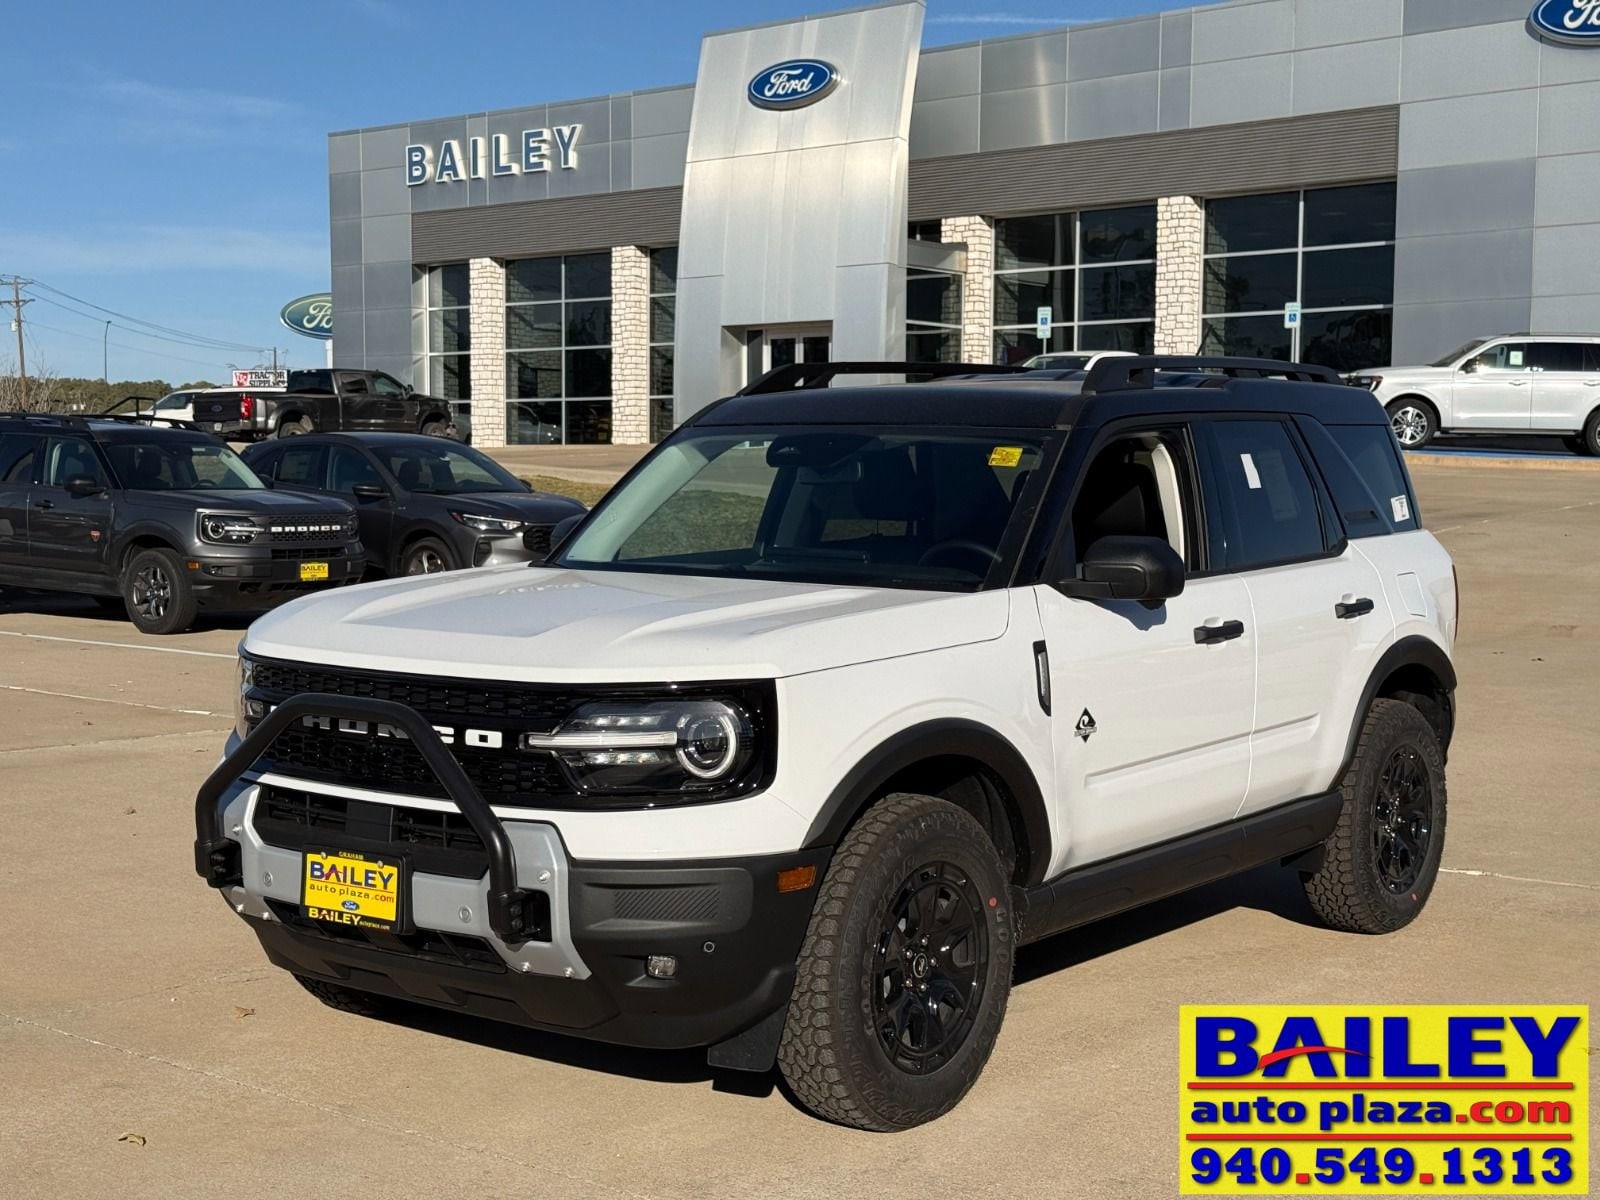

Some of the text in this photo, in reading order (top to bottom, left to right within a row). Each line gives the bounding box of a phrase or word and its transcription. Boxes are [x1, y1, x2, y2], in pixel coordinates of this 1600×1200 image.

[764, 69, 814, 96] Ford
[406, 124, 582, 186] BAILEY
[249, 371, 285, 379] TRACTOR
[270, 705, 503, 749] RONCO
[339, 851, 364, 860] GRAHAM
[310, 861, 394, 890] BAILEY
[309, 883, 395, 903] auto plaza.com
[308, 907, 361, 926] BAILEY
